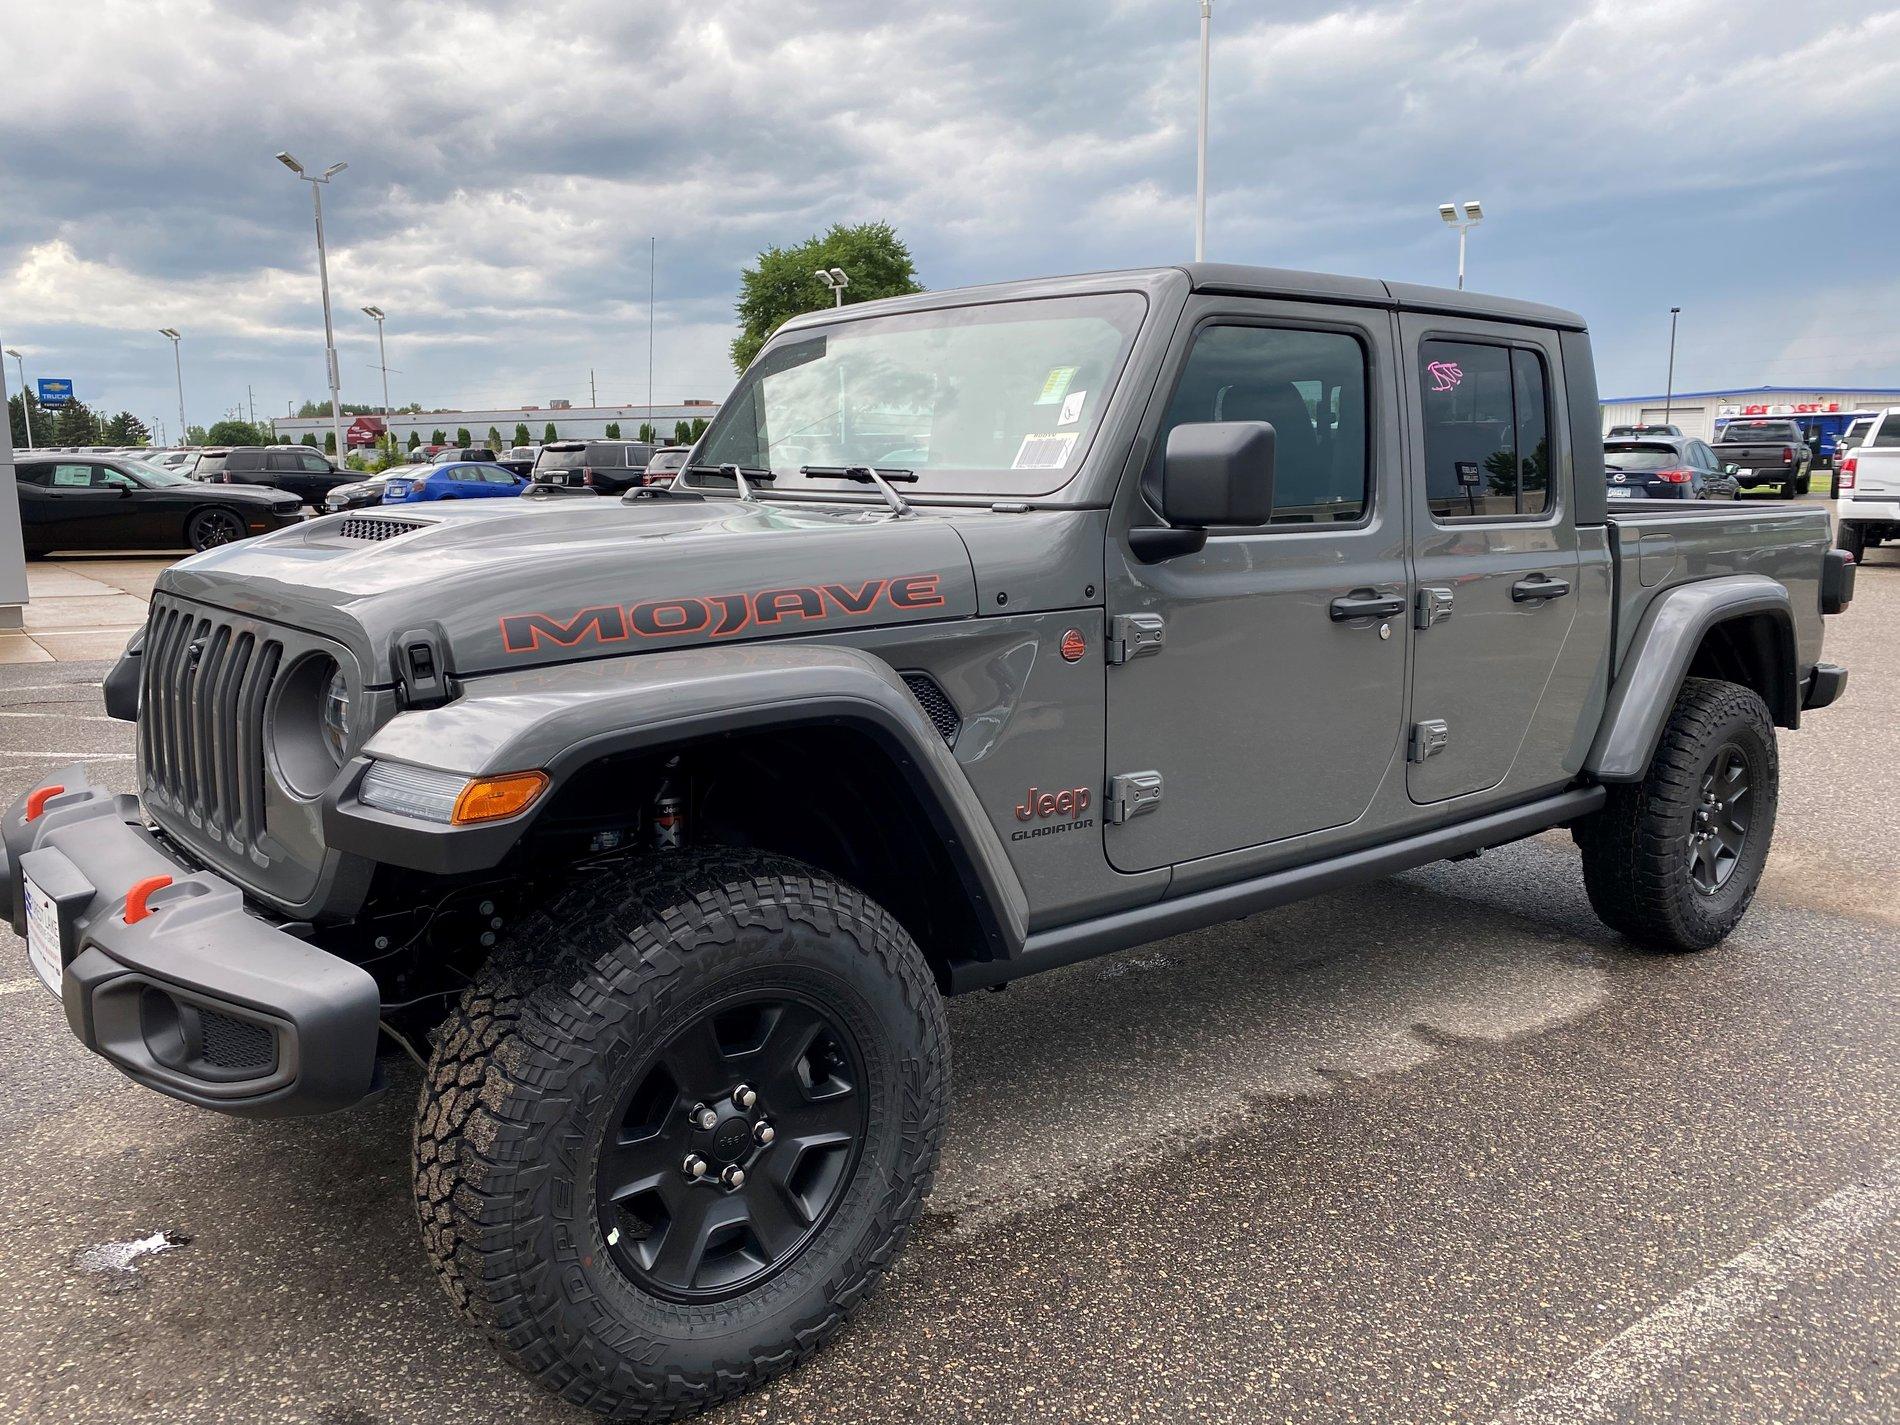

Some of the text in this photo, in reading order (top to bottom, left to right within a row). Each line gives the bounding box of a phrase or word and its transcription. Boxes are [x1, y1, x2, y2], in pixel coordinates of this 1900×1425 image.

[500, 574, 945, 653] MOJAVE
[1011, 819, 1094, 841] GLADIATOR
[1015, 787, 1092, 821] Jeep
[550, 1081, 669, 1366] WILDPEAK
